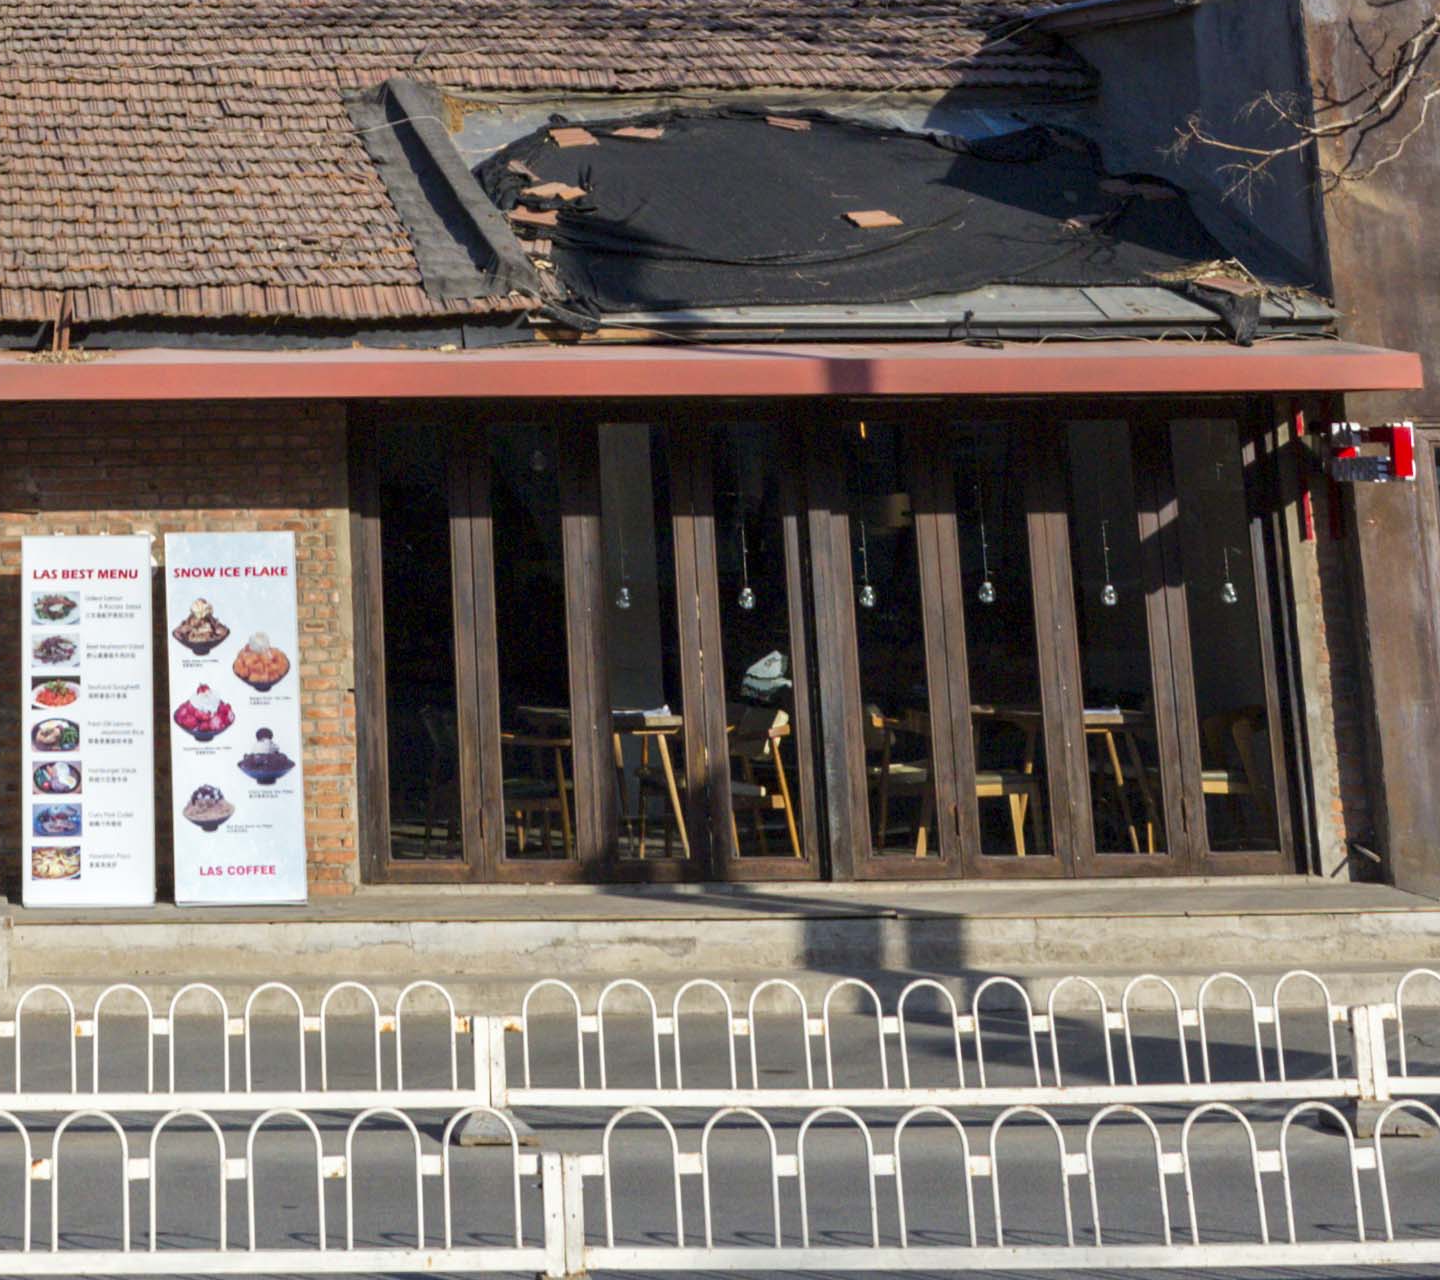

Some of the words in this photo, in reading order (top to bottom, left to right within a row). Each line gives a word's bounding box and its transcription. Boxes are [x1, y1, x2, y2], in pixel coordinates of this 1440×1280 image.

[32, 569, 58, 580] LAS
[61, 569, 95, 579] BEST
[97, 568, 139, 579] MENU
[173, 567, 216, 579] SNOW
[219, 566, 241, 578] ICE
[244, 565, 288, 577] FLAKE
[199, 866, 223, 877] LAS
[227, 865, 276, 876] COFFEE
